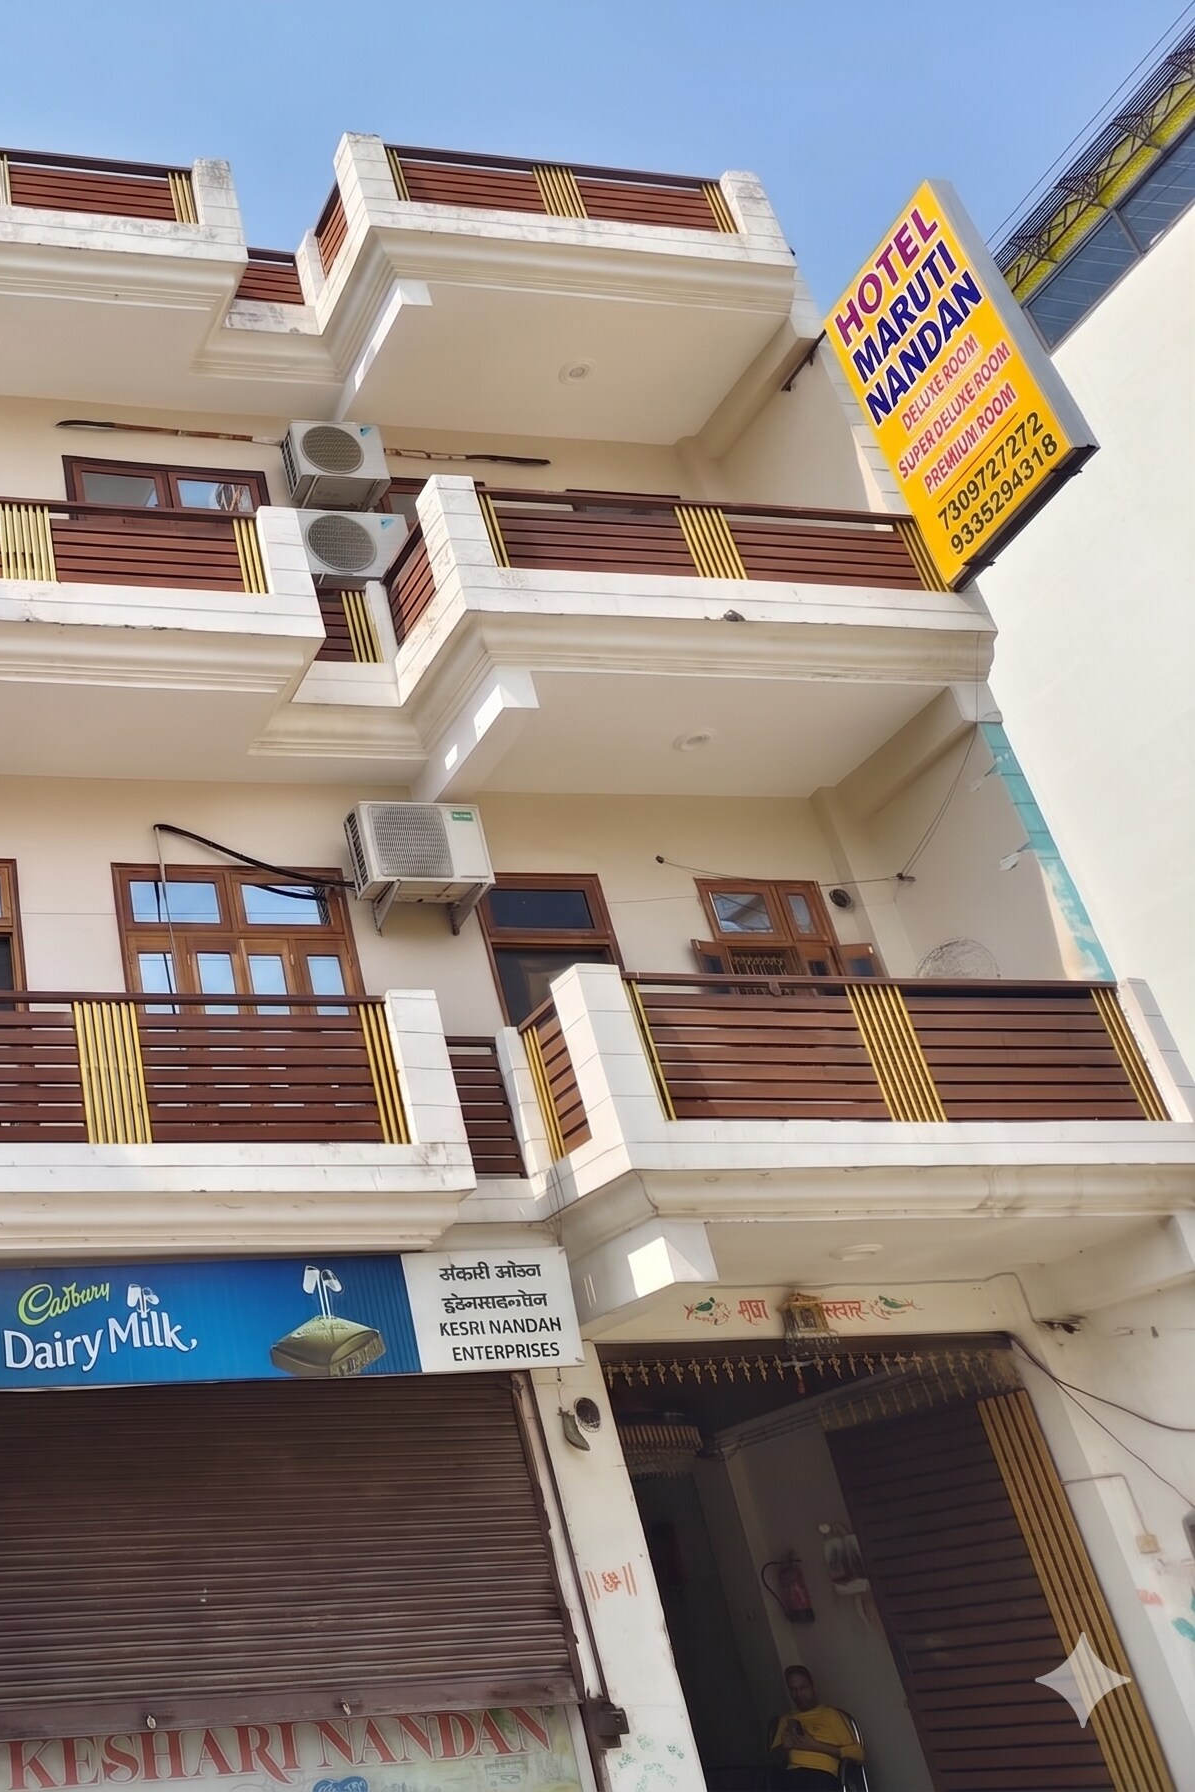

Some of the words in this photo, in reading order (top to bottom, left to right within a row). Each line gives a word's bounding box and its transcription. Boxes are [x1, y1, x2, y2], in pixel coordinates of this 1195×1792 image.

[835, 208, 938, 347] HOTEL
[852, 240, 956, 383] MARUTI
[865, 270, 983, 425] NANDAN
[901, 374, 946, 432] DELUXE
[942, 333, 979, 384] ROOM
[898, 430, 936, 479] SUPER
[933, 382, 976, 442] DELUXE
[974, 342, 1011, 392] ROOM
[924, 424, 979, 494] PREMIUM
[976, 382, 1016, 435] ROOM
[938, 411, 1043, 531] 7309727272
[951, 433, 1058, 554] 9335294318
[3, 1329, 104, 1372] Dairy
[18, 1282, 110, 1326] Cadbury
[439, 1320, 486, 1337] KESRI
[452, 1342, 560, 1361] ENTERPRISES
[7, 1720, 303, 1790] KESHARI
[308, 1706, 552, 1769] NANDAN
